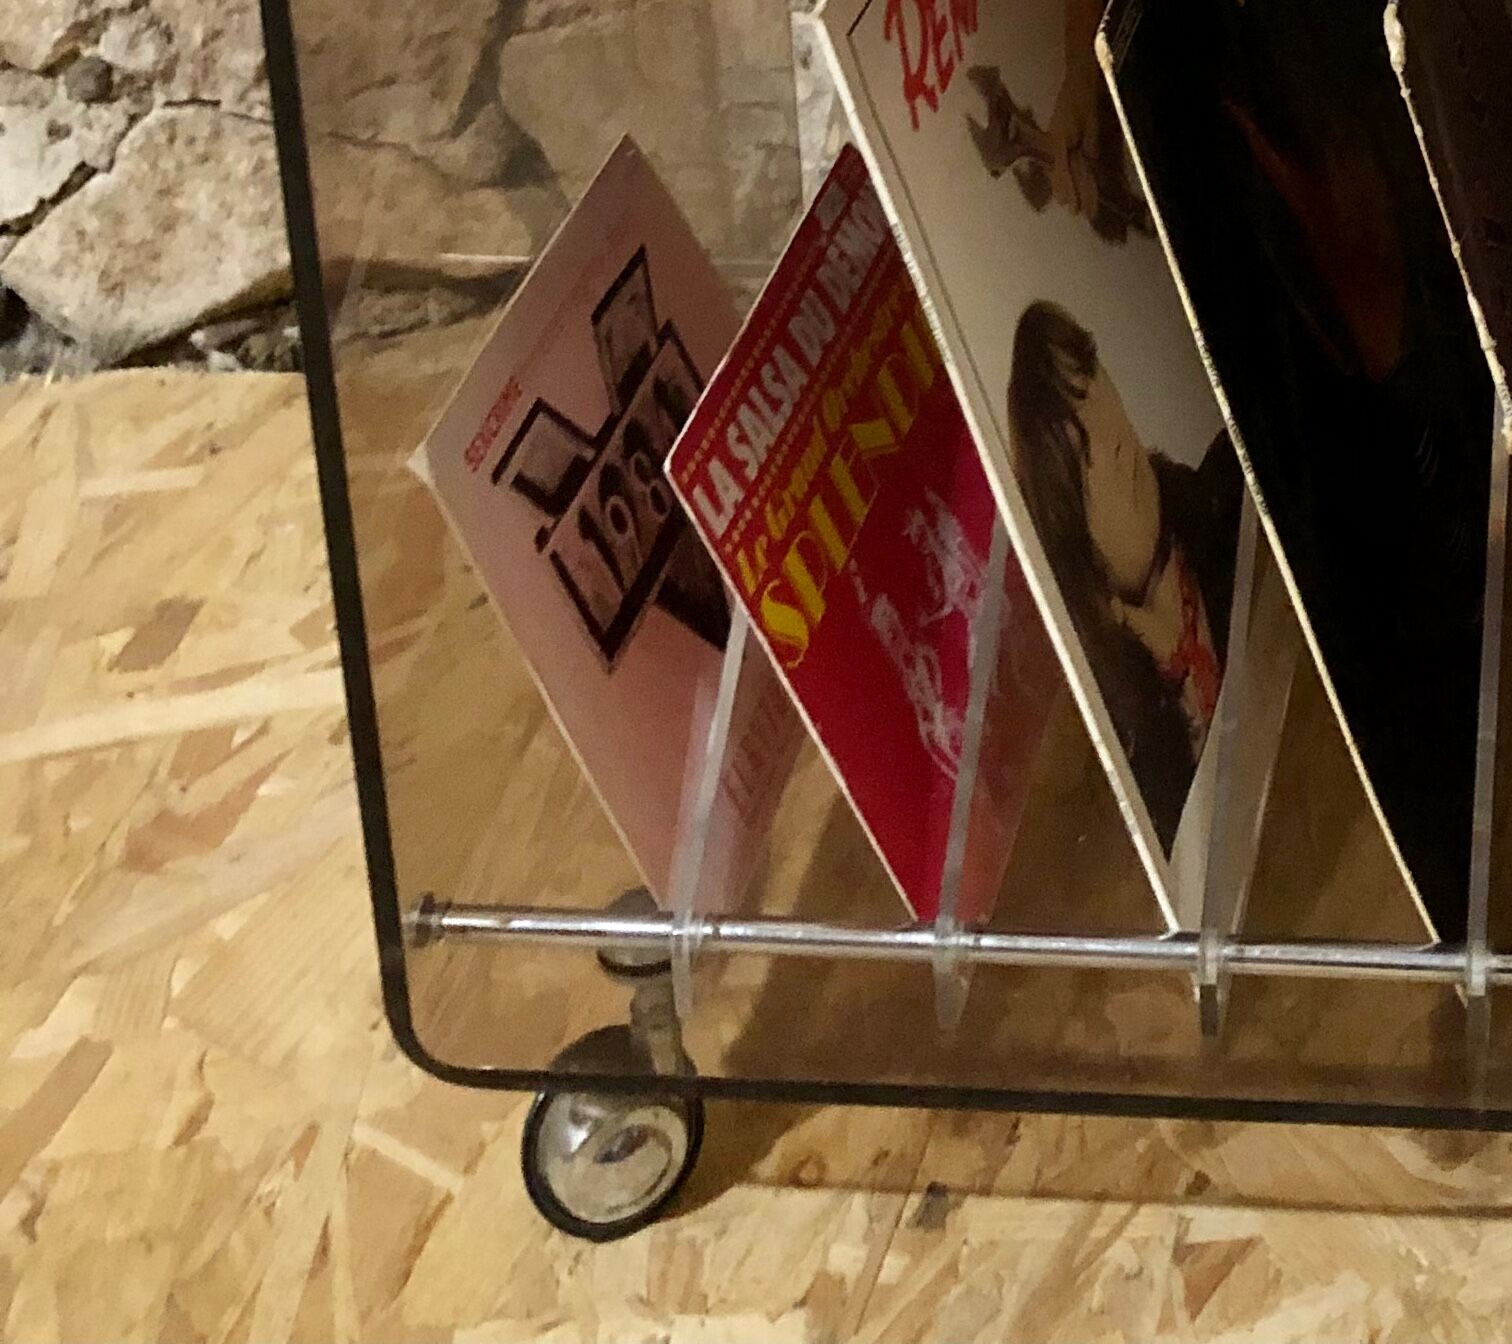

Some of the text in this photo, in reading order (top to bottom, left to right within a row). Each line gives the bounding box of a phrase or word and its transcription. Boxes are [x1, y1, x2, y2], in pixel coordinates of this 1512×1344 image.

[692, 455, 745, 539] LA
[727, 344, 810, 481] SALSA
[788, 287, 836, 368] DU
